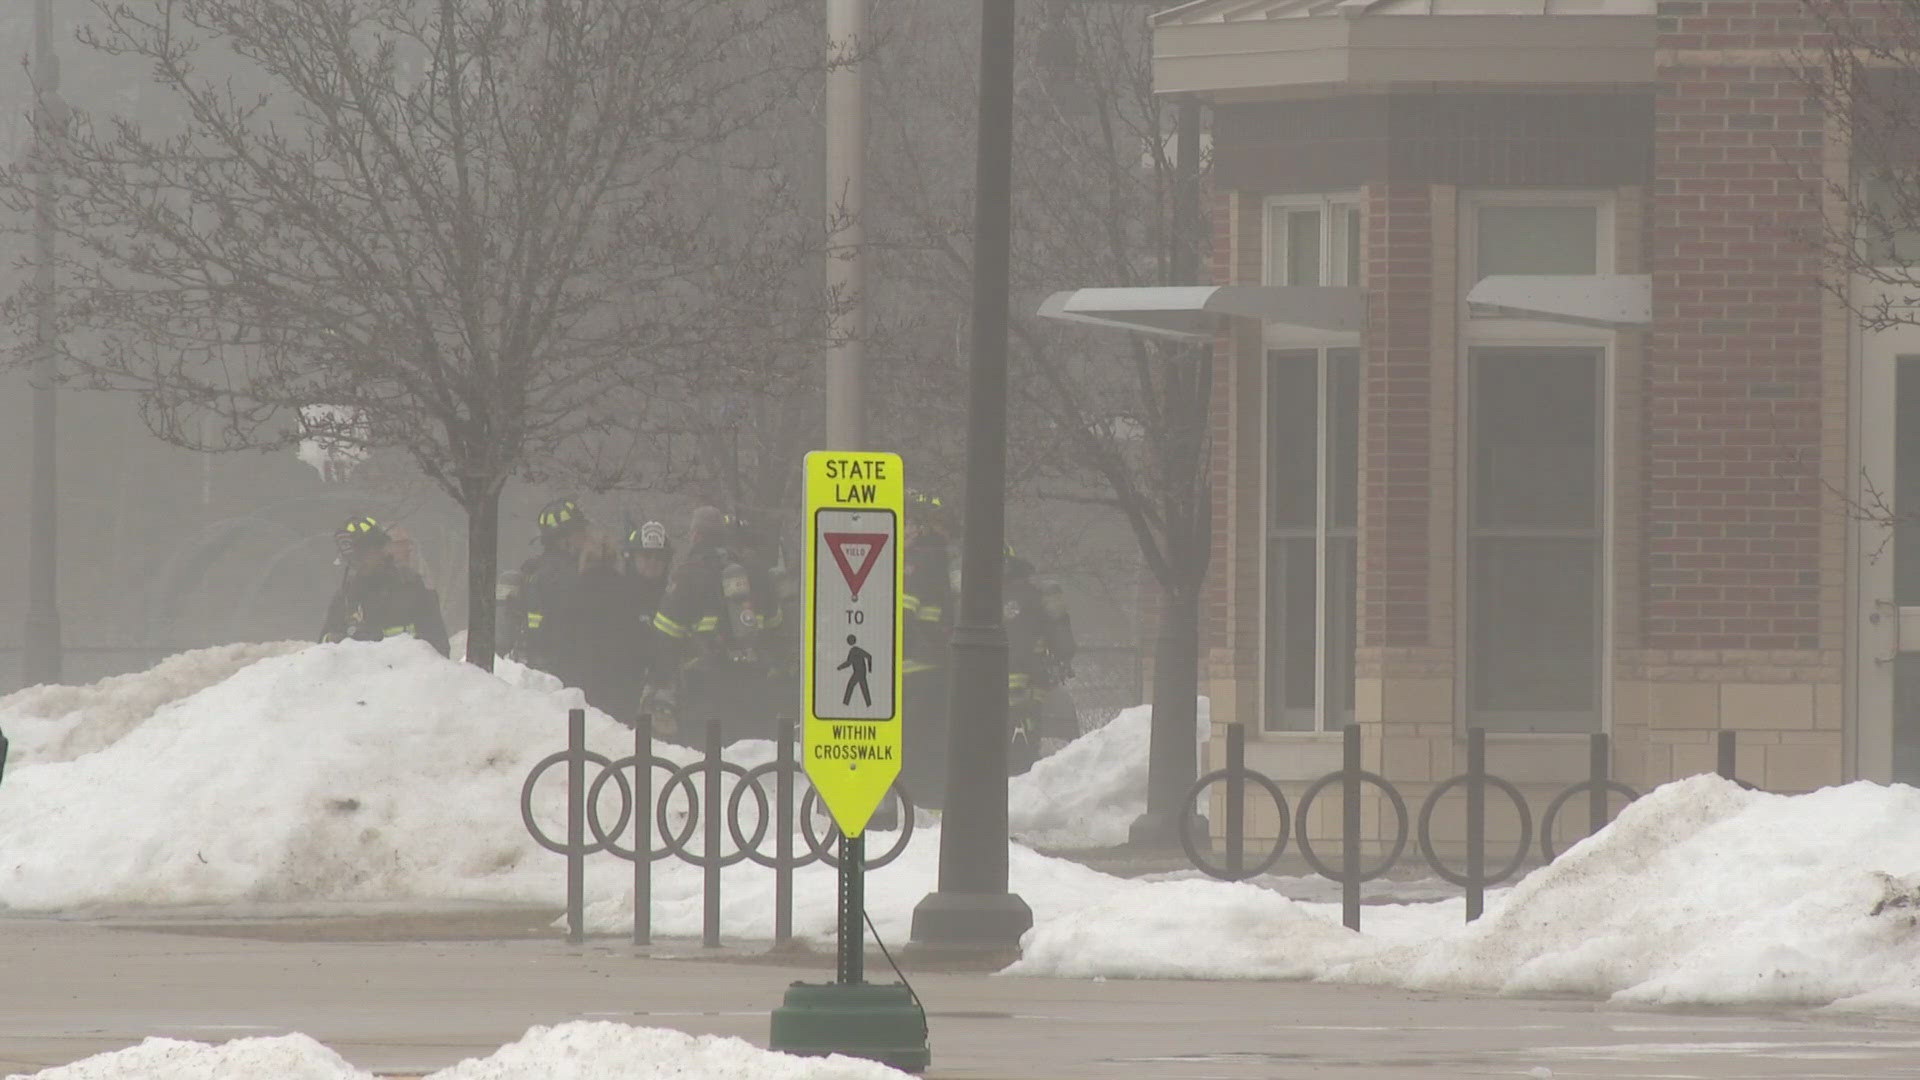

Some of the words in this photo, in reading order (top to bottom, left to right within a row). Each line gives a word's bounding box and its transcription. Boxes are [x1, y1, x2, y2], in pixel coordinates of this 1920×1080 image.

[826, 460, 886, 480] STATE
[836, 484, 876, 504] LAW
[846, 548, 866, 557] YIELD
[846, 610, 864, 625] TO
[832, 725, 876, 740] WITHIN
[814, 745, 892, 760] CROSSWALK
